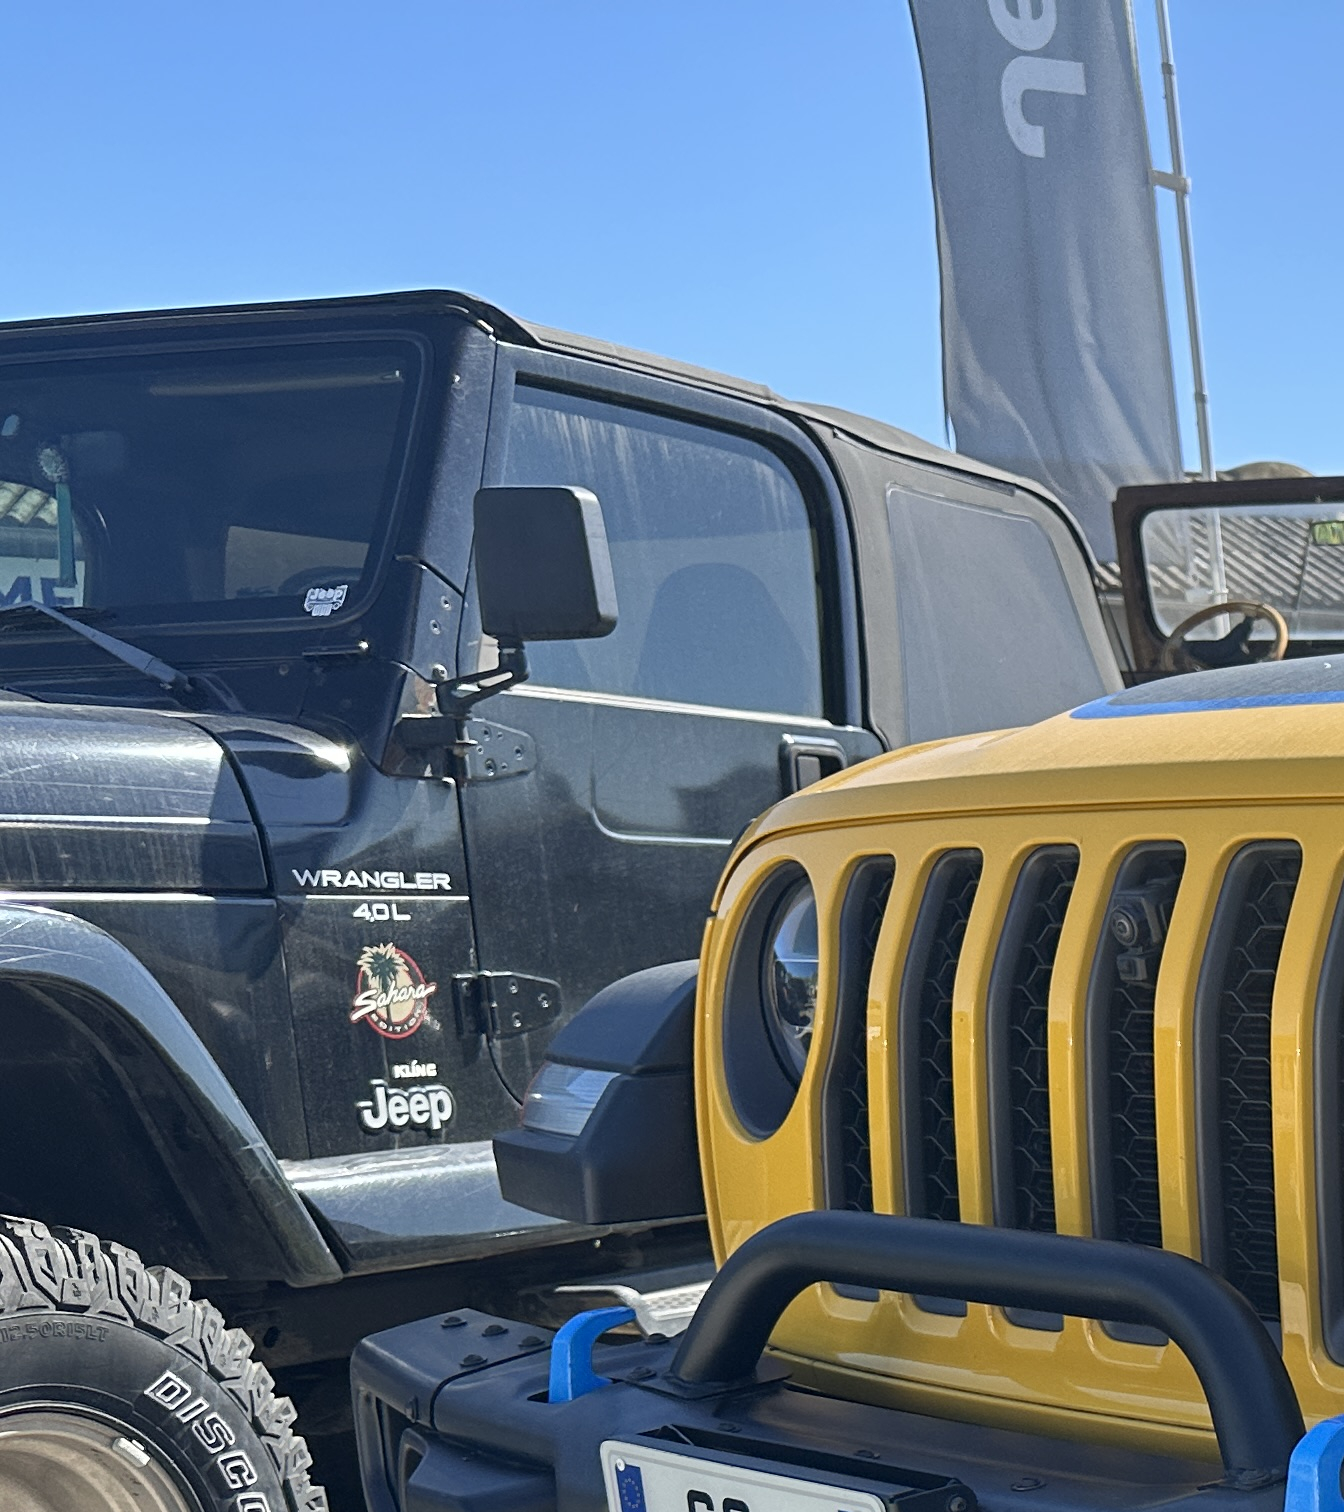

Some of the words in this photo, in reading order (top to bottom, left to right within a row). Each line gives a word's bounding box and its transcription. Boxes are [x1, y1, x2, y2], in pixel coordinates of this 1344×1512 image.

[292, 869, 452, 890] WRANGLER
[351, 982, 437, 1021] Sahara
[355, 1079, 455, 1132] Jeep
